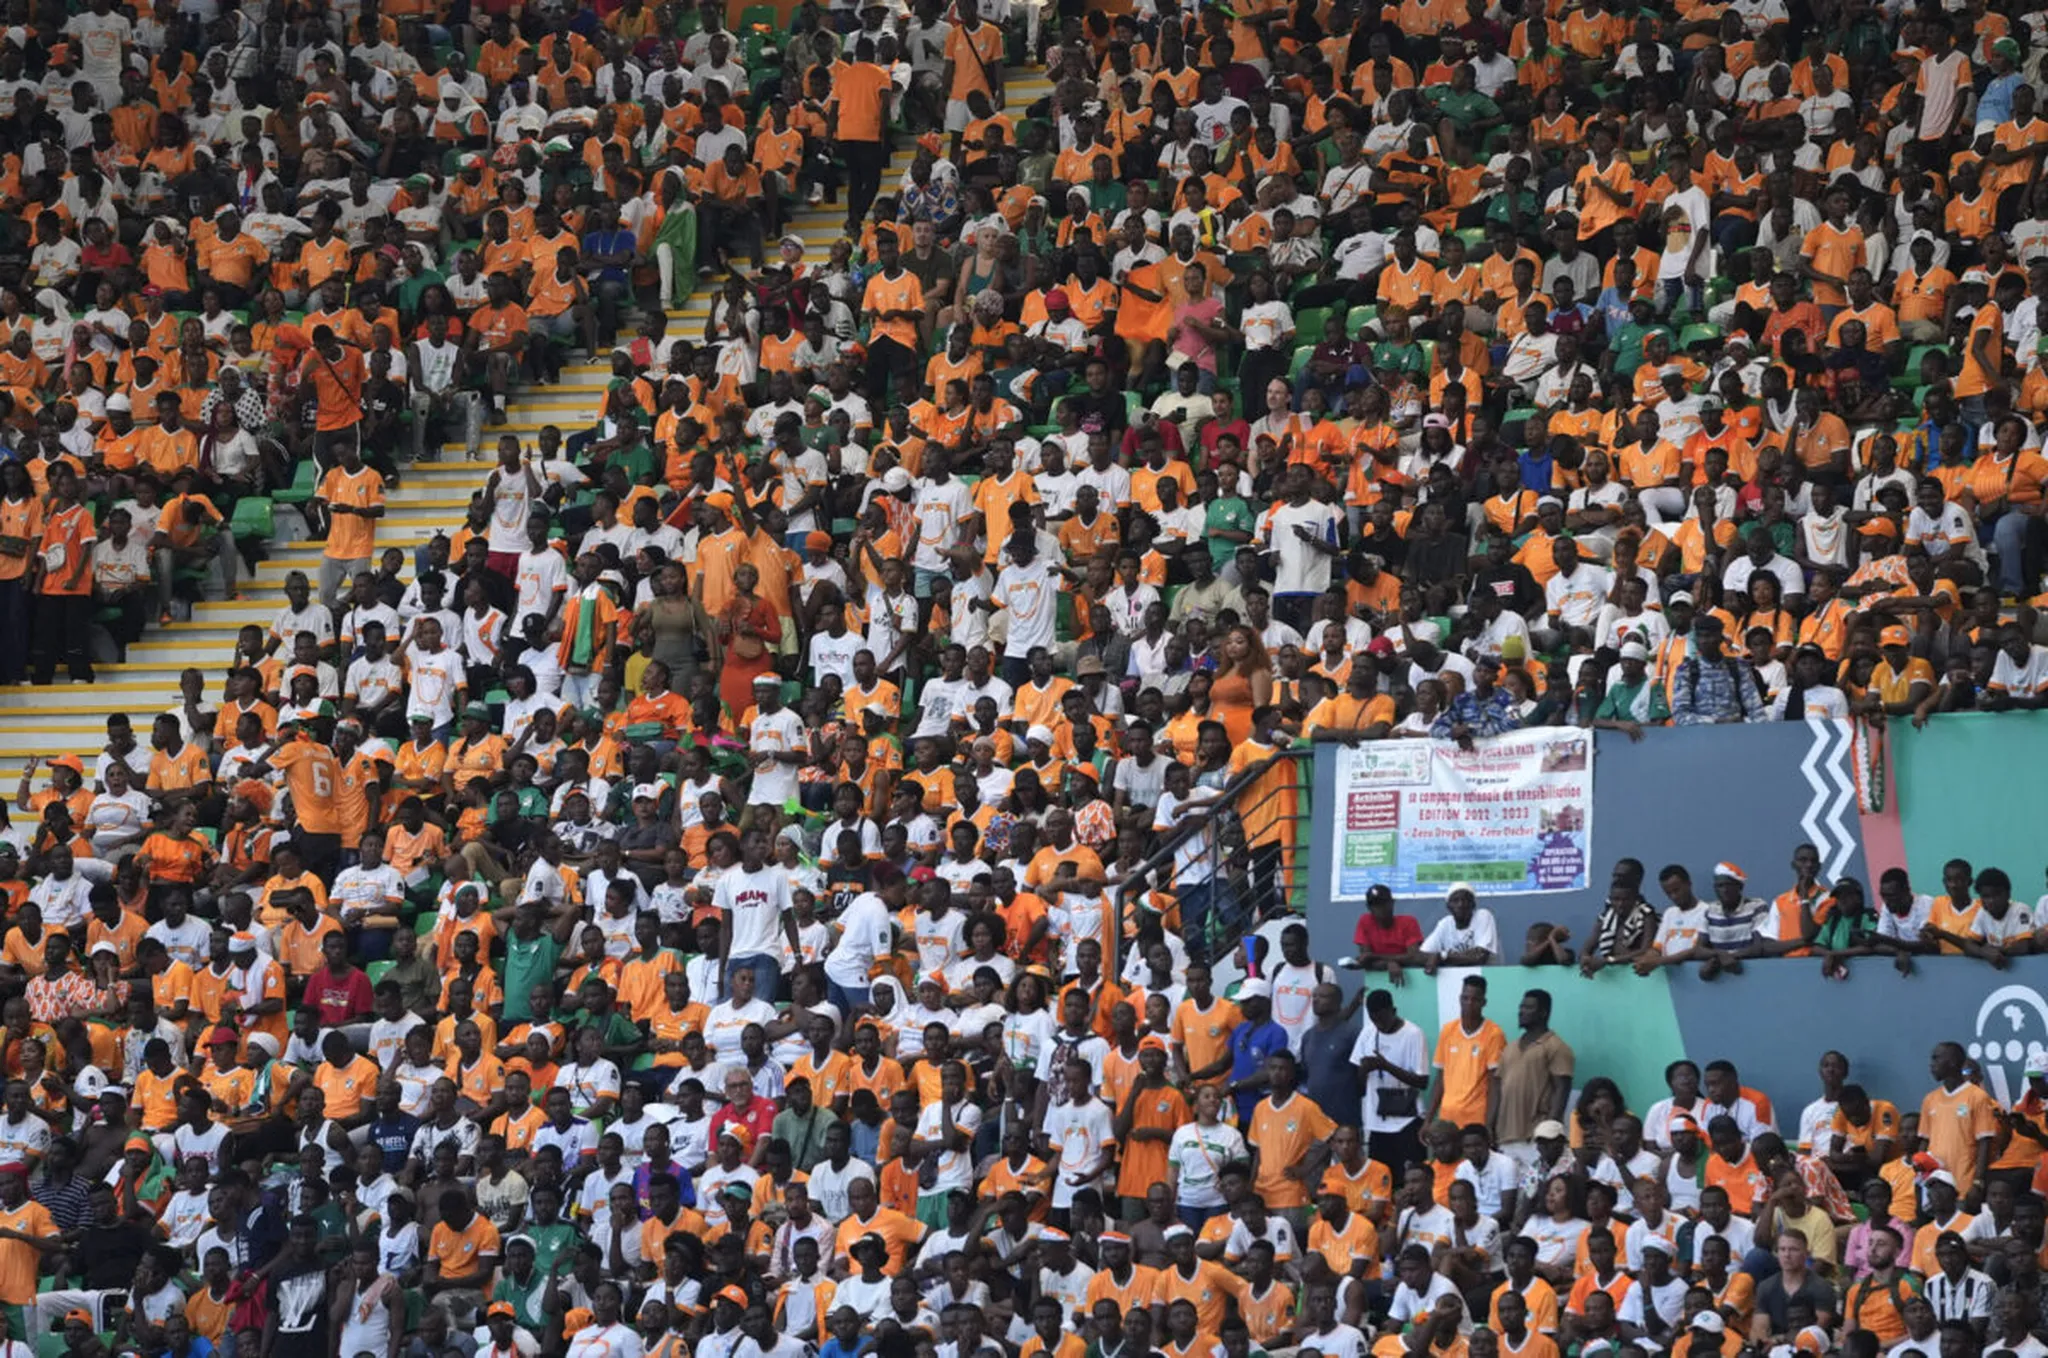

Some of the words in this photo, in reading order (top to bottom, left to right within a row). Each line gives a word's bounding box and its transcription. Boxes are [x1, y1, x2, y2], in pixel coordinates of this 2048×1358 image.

[312, 761, 331, 797] 6
[1419, 808, 1460, 820] EDITION
[1465, 808, 1489, 820] 2022
